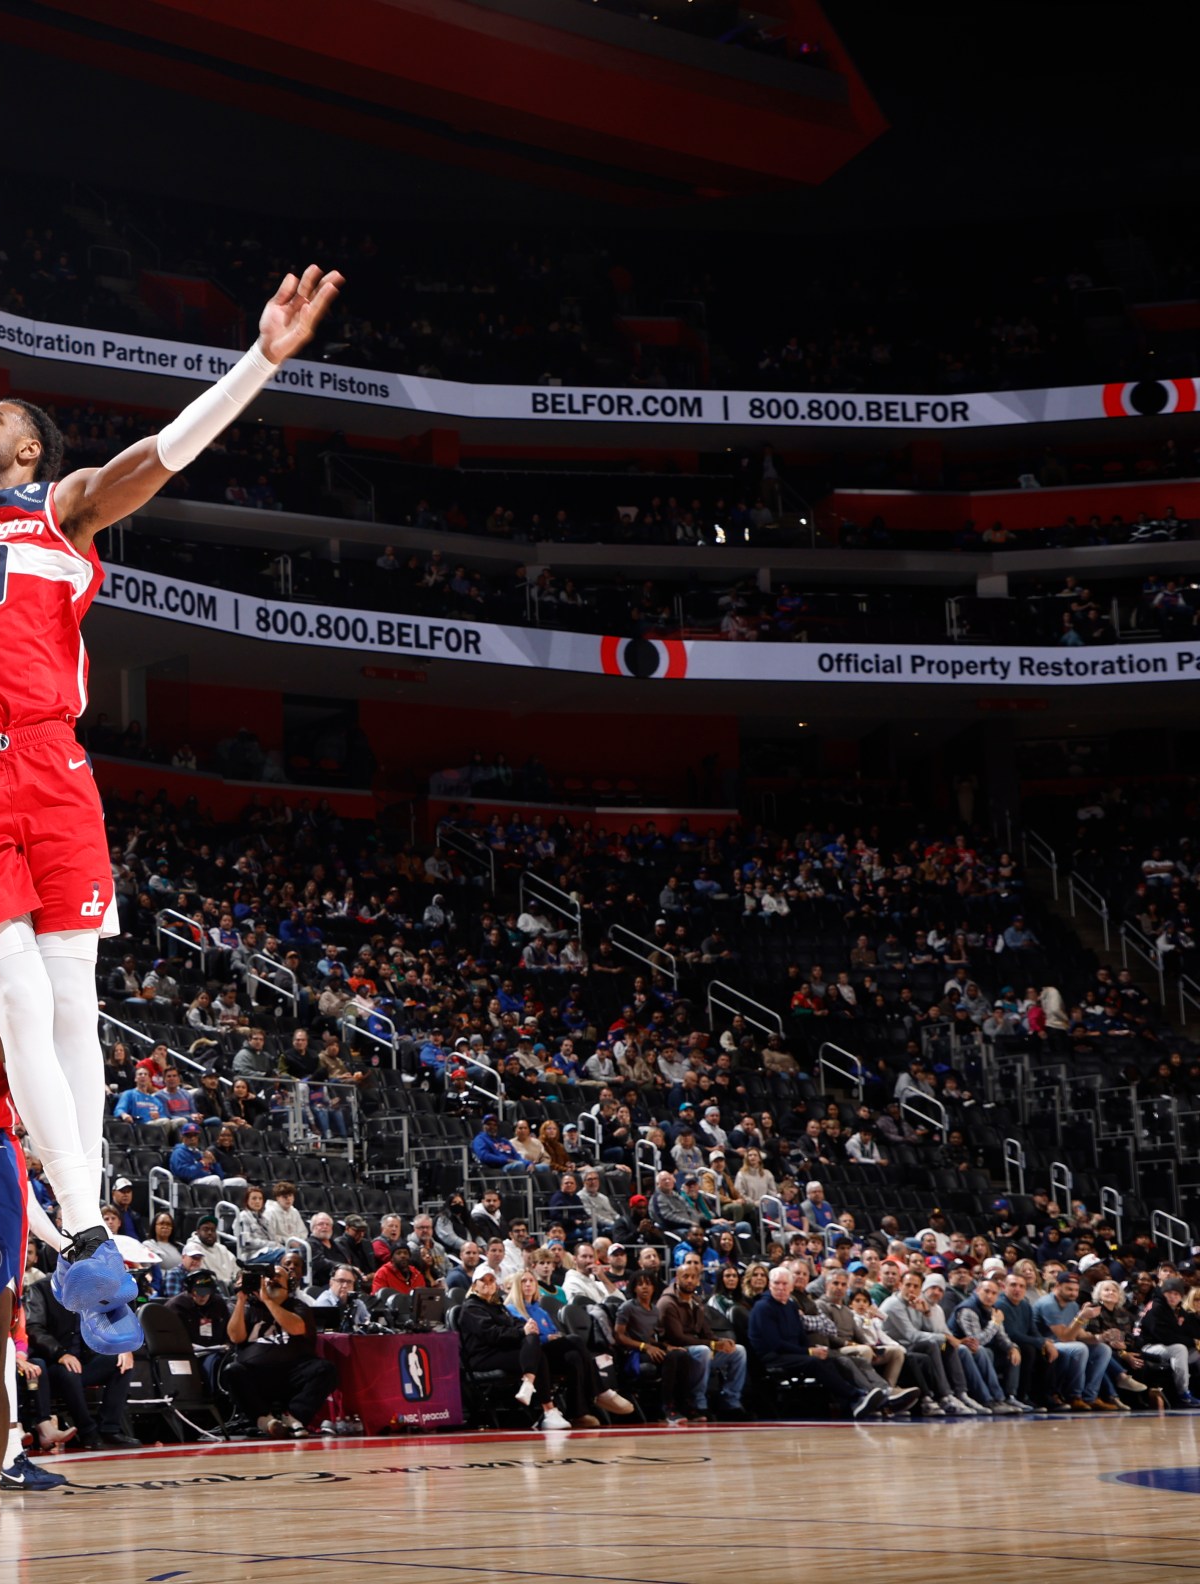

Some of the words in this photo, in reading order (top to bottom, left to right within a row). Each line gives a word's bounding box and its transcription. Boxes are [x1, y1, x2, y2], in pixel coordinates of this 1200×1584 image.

[103, 341, 177, 372] Partner
[184, 354, 203, 371] of
[271, 367, 314, 388] troit
[320, 372, 390, 398] Pistons
[531, 391, 703, 418] BELFOR.COM
[749, 397, 970, 424] 800.800.BELFOR
[97, 572, 217, 621] LFOR.COM
[256, 608, 482, 655] 800.800.BELFOR
[818, 653, 902, 674] Official
[911, 655, 1012, 680] Property
[1019, 653, 1168, 677] Restoration
